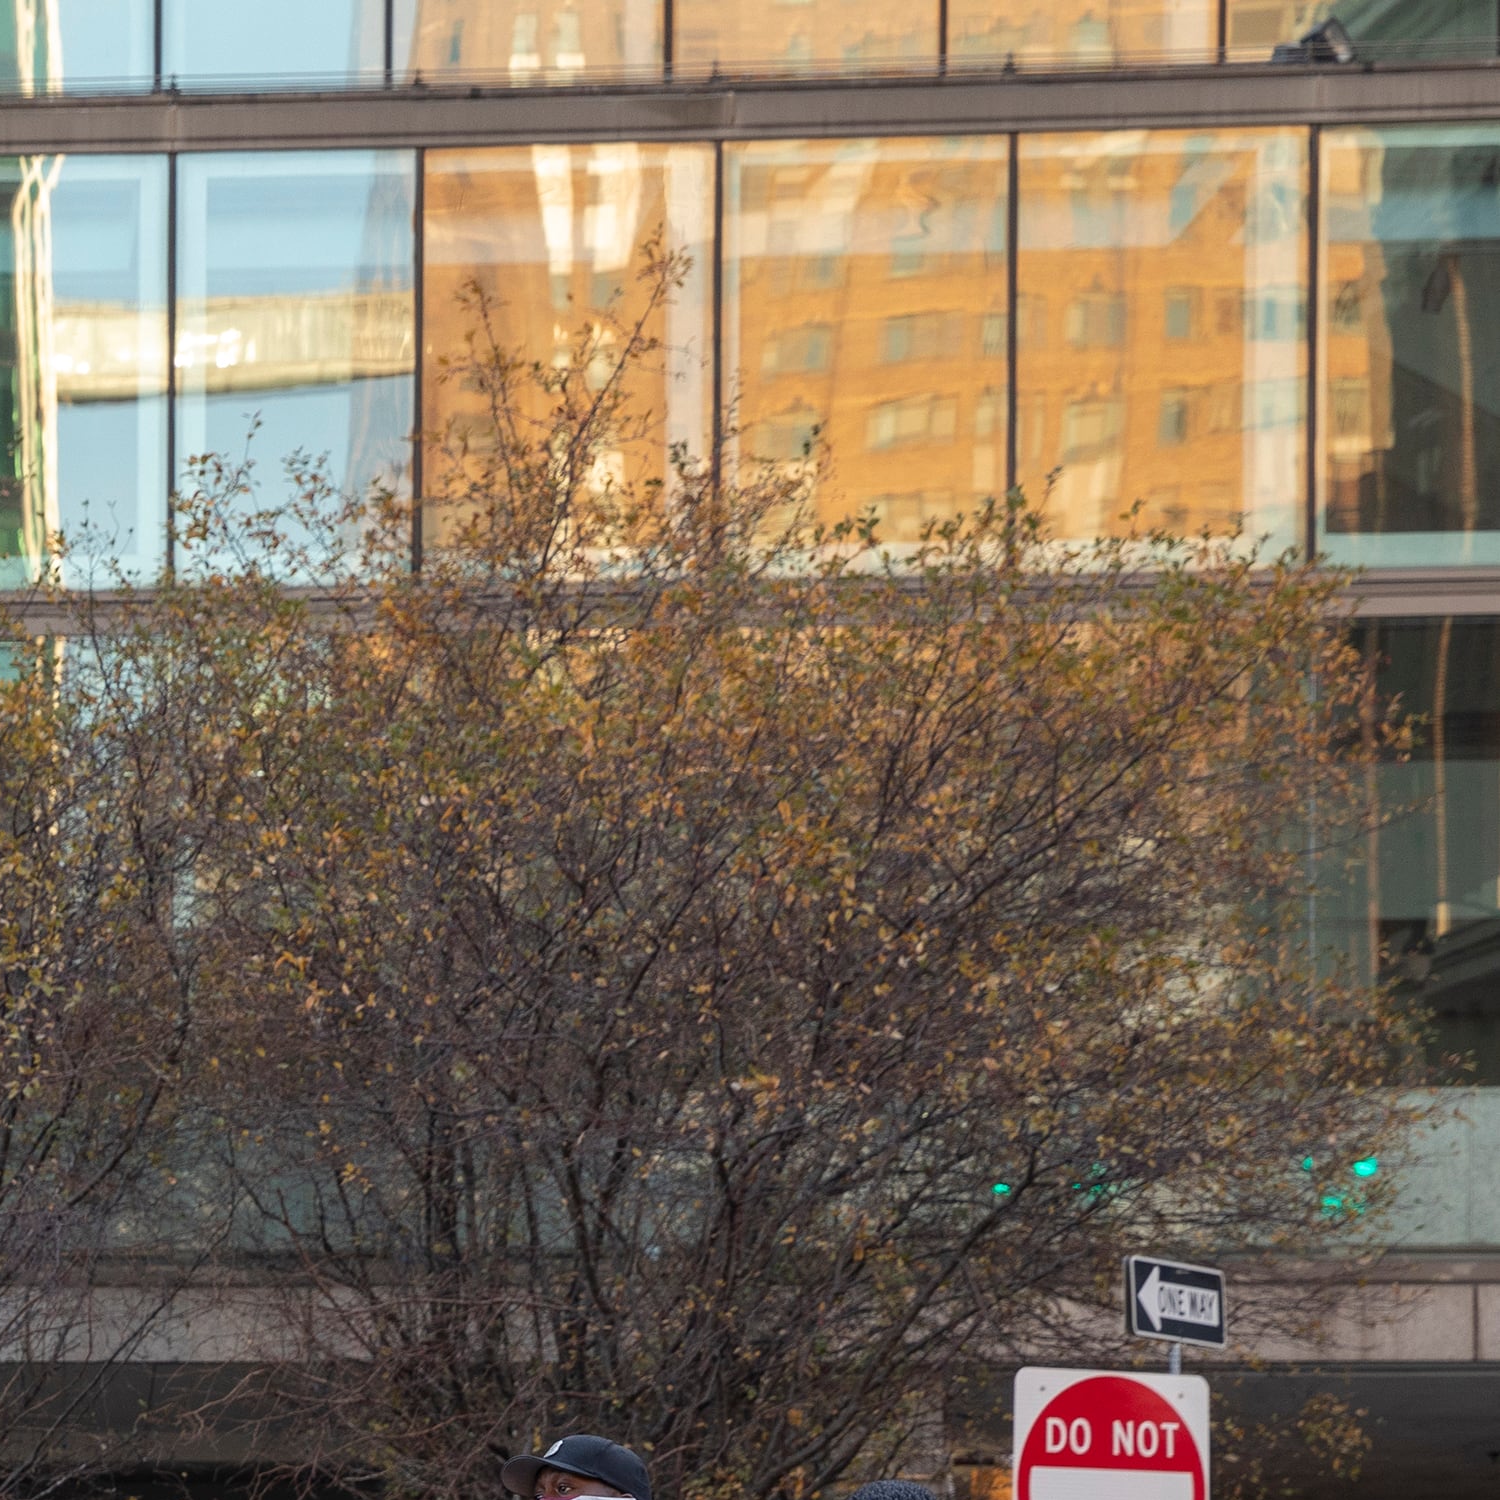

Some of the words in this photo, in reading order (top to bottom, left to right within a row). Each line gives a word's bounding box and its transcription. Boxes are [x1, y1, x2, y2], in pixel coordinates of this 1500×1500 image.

[1157, 1285, 1186, 1316] ONE
[1044, 1416, 1092, 1456] DO
[1111, 1419, 1181, 1460] NOT
